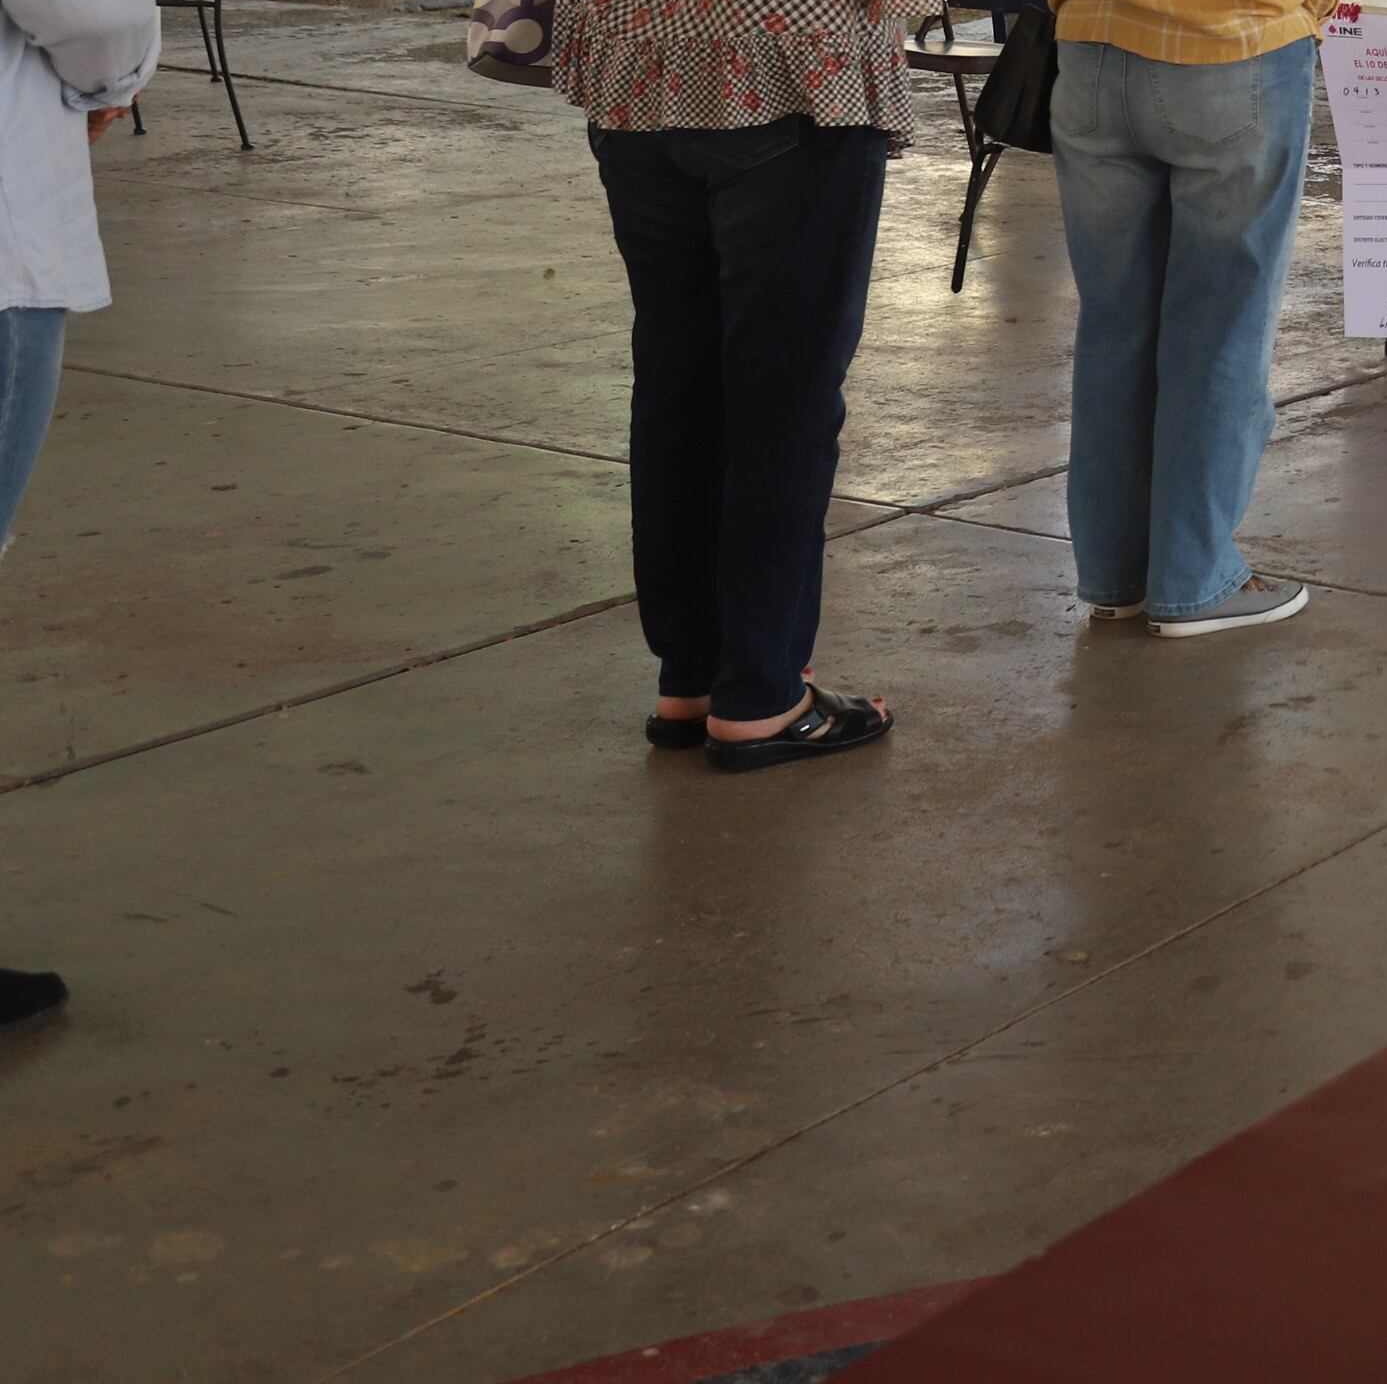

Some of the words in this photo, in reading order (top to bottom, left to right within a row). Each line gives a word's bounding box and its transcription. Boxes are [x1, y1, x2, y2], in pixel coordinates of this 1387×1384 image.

[1338, 26, 1363, 36] INE
[1365, 47, 1387, 57] AQUÍ
[1353, 59, 1363, 68] EL
[1365, 60, 1376, 69] 10
[1352, 258, 1381, 268] Verifica
